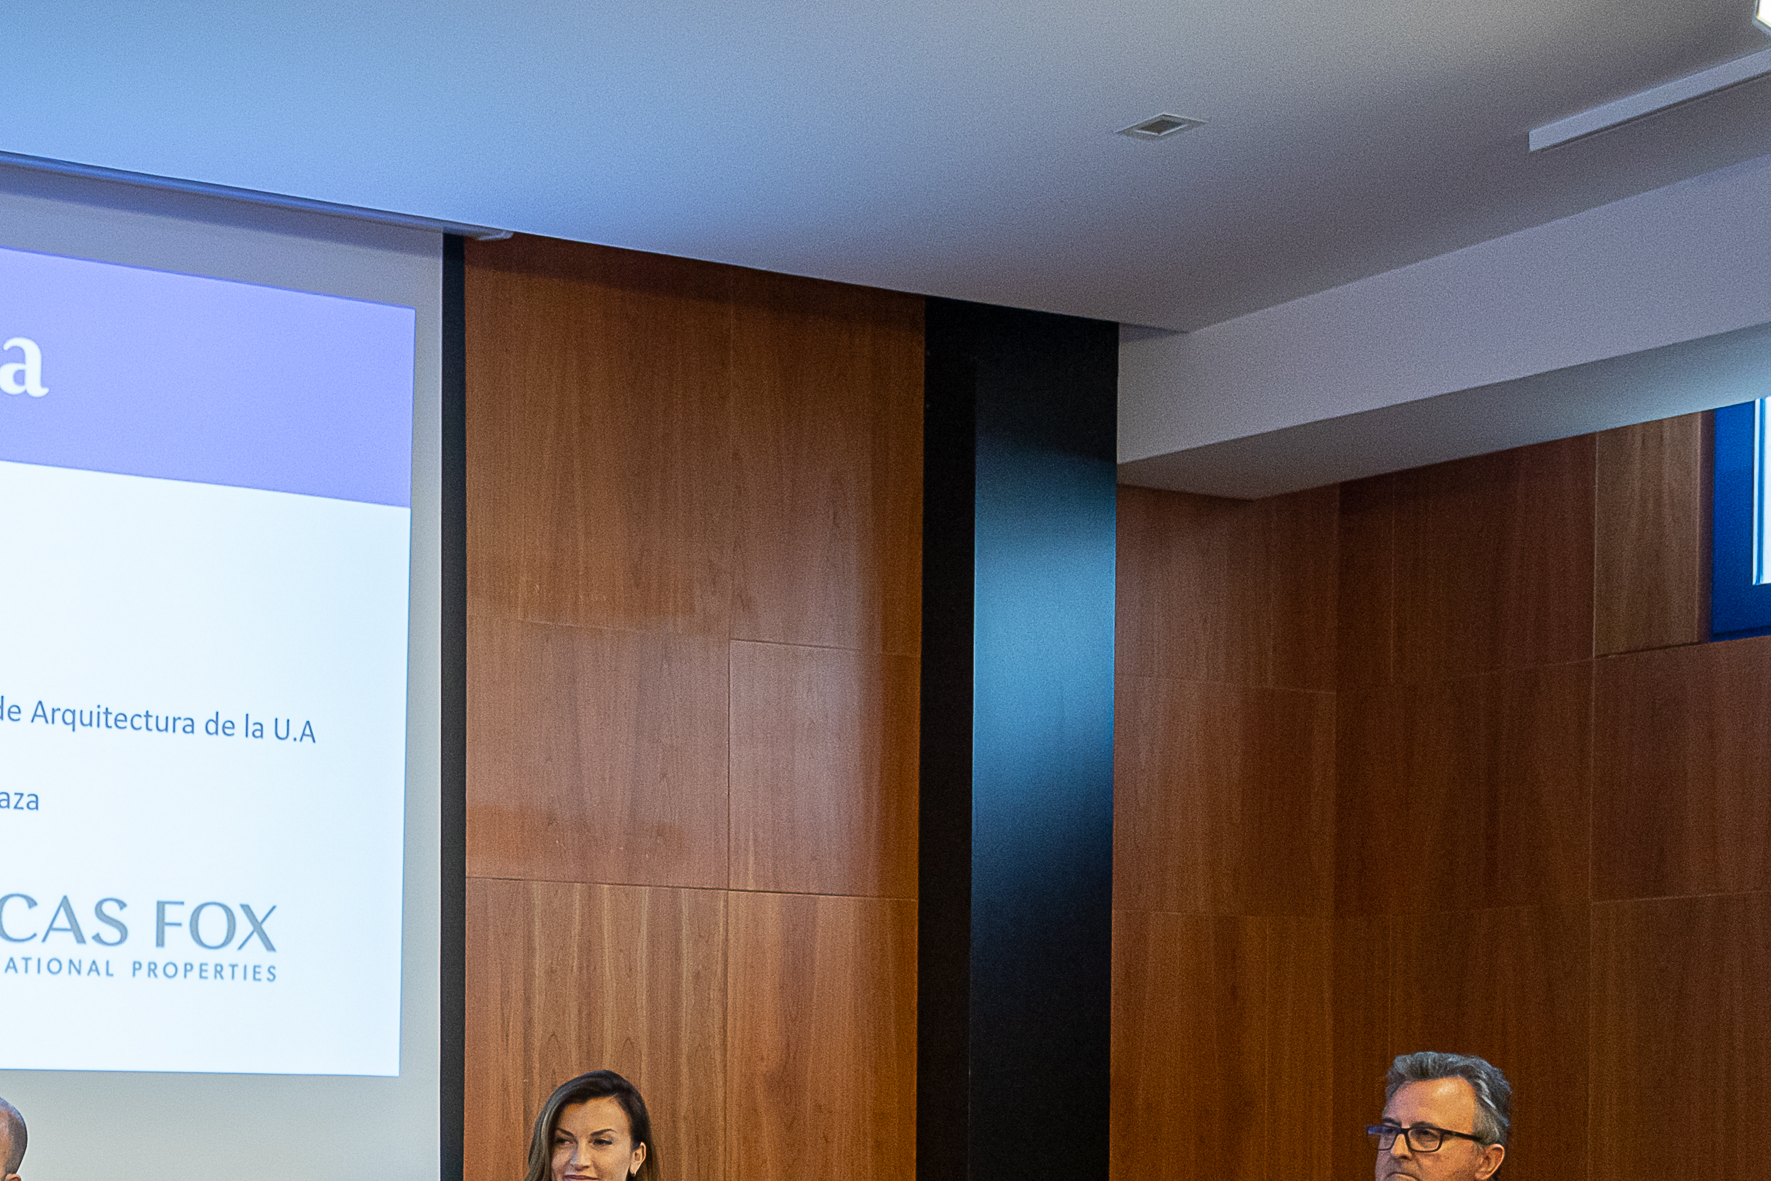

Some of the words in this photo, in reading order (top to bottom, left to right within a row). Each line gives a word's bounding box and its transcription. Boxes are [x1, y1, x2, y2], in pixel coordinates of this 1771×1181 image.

[30, 700, 195, 735] Arquitectura
[205, 711, 235, 737] de
[245, 713, 264, 739] la
[274, 717, 316, 744] U.A
[155, 900, 277, 953] FOX
[132, 960, 276, 982] PROPERTIES
